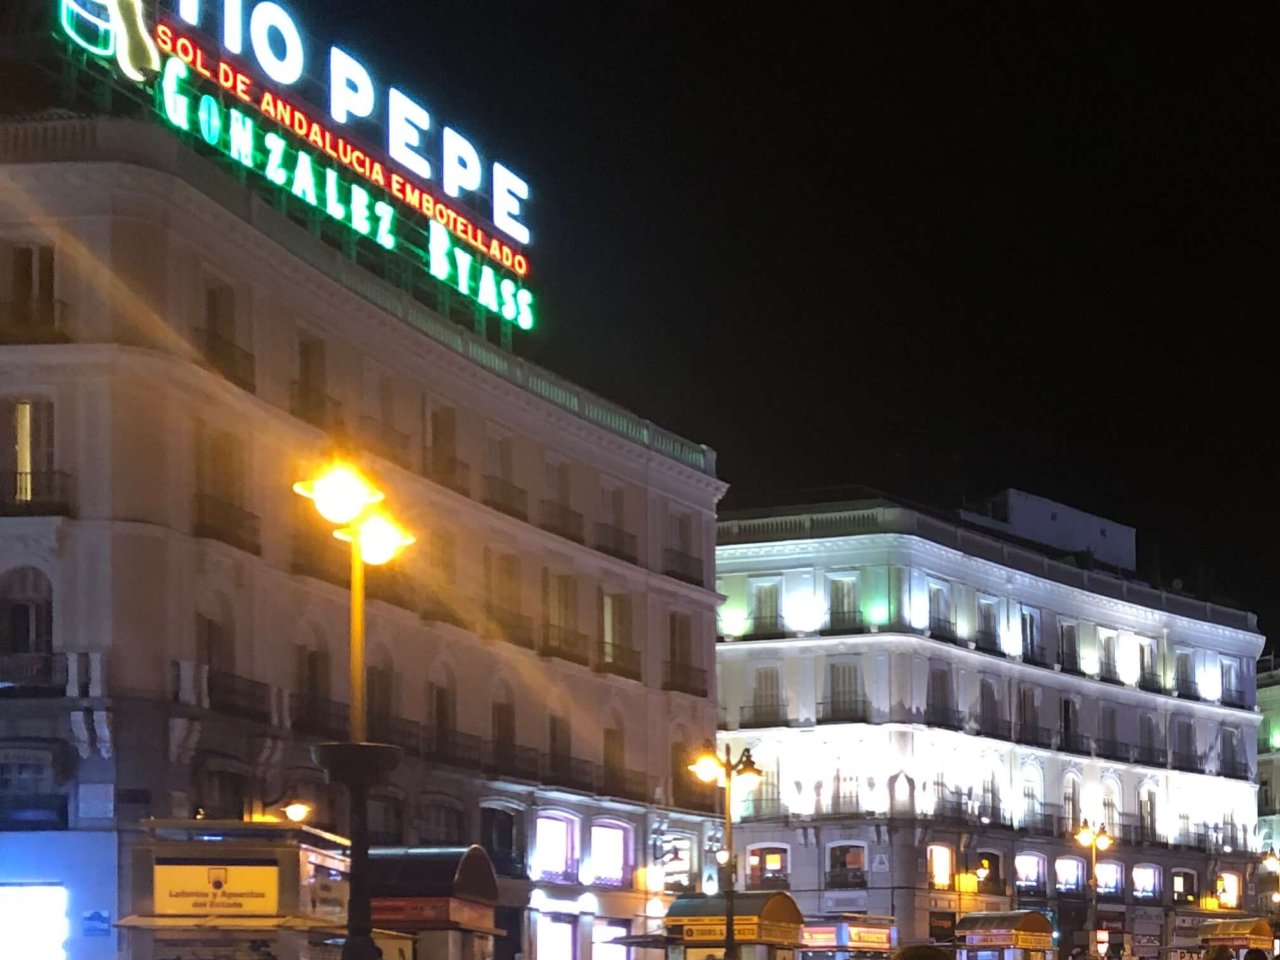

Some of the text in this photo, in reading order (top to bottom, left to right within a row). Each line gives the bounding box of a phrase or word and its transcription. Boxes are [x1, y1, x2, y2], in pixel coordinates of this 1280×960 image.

[156, 24, 528, 277] SOL DE ANDALUCIA EMBOTELLADO
[162, 55, 534, 331] GONZALEZ BYASS
[330, 46, 531, 245] PEPE
